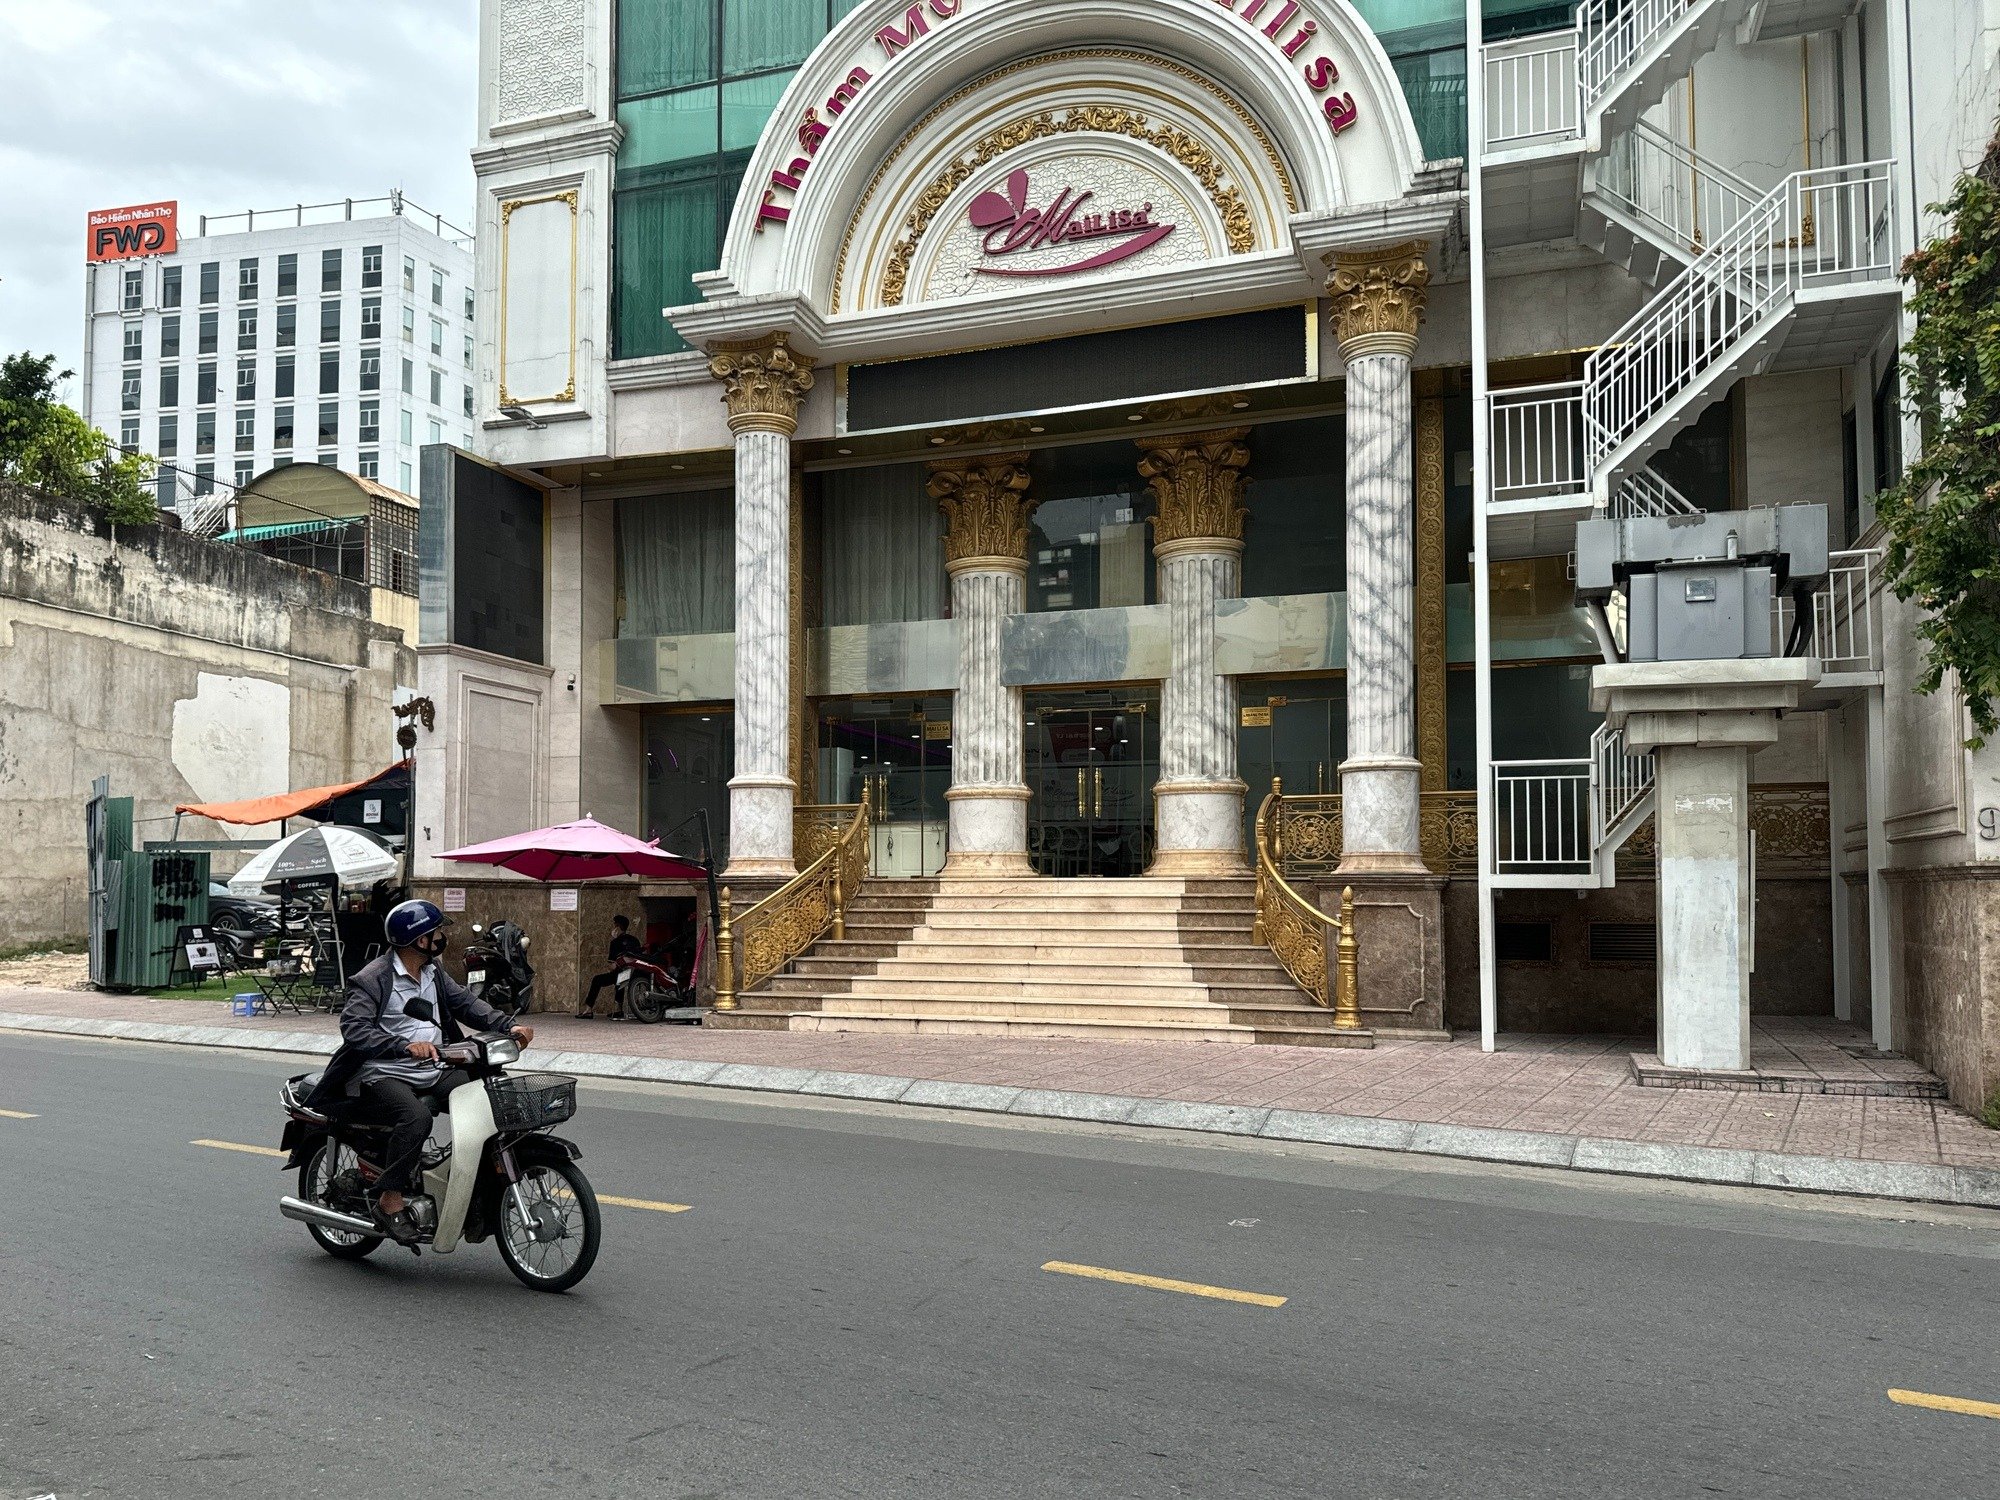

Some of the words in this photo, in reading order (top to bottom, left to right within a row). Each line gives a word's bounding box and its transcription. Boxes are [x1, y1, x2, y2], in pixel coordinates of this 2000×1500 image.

[755, 66, 873, 232] Thẩm
[91, 213, 108, 225] Bảo
[108, 209, 131, 224] Hiểm
[132, 209, 154, 220] Nhân
[155, 207, 172, 218] Thọ
[96, 222, 164, 256] FWD
[278, 861, 295, 869] 100%
[297, 881, 320, 889] COFFEE
